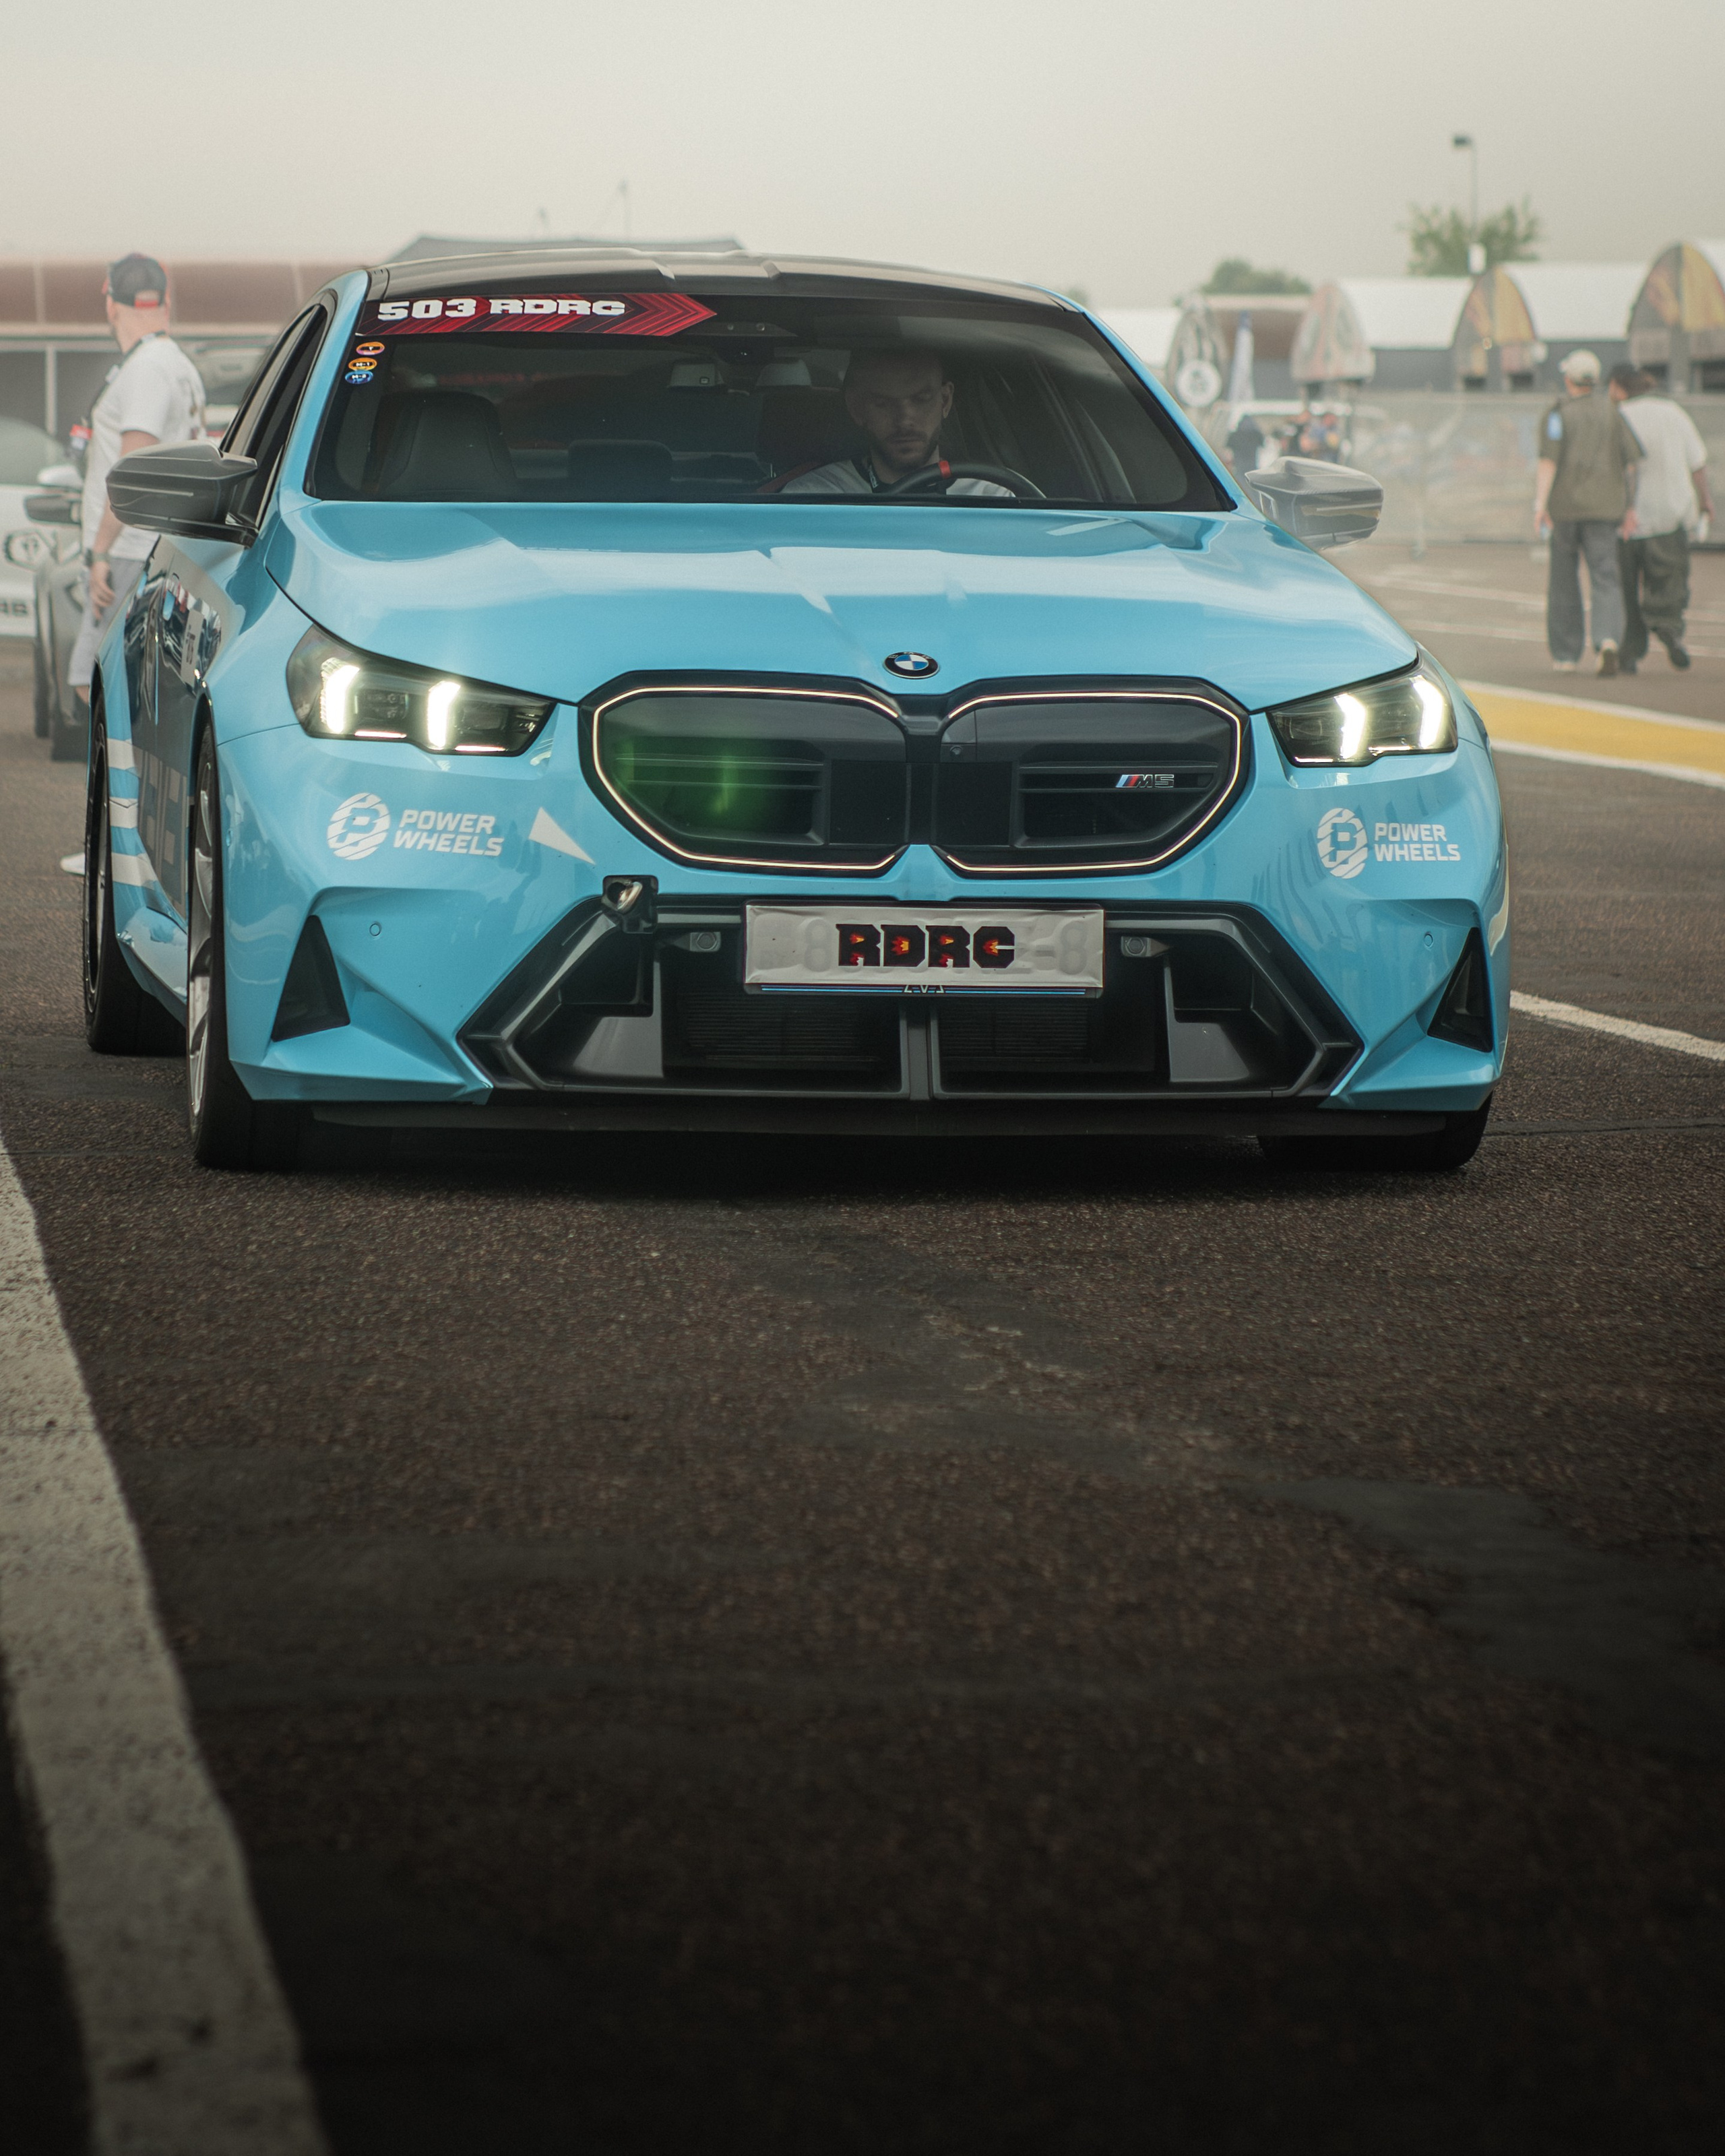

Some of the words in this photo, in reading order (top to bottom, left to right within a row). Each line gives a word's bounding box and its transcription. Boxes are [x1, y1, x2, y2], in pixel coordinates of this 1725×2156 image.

[377, 298, 477, 321] 503
[489, 298, 625, 316] RDRC
[1135, 774, 1174, 788] M5
[398, 808, 496, 835] POWER
[1374, 823, 1447, 842] POWER
[393, 829, 505, 857] WHEELS
[1374, 844, 1462, 862] WHEELS
[836, 924, 1015, 968] RDRC
